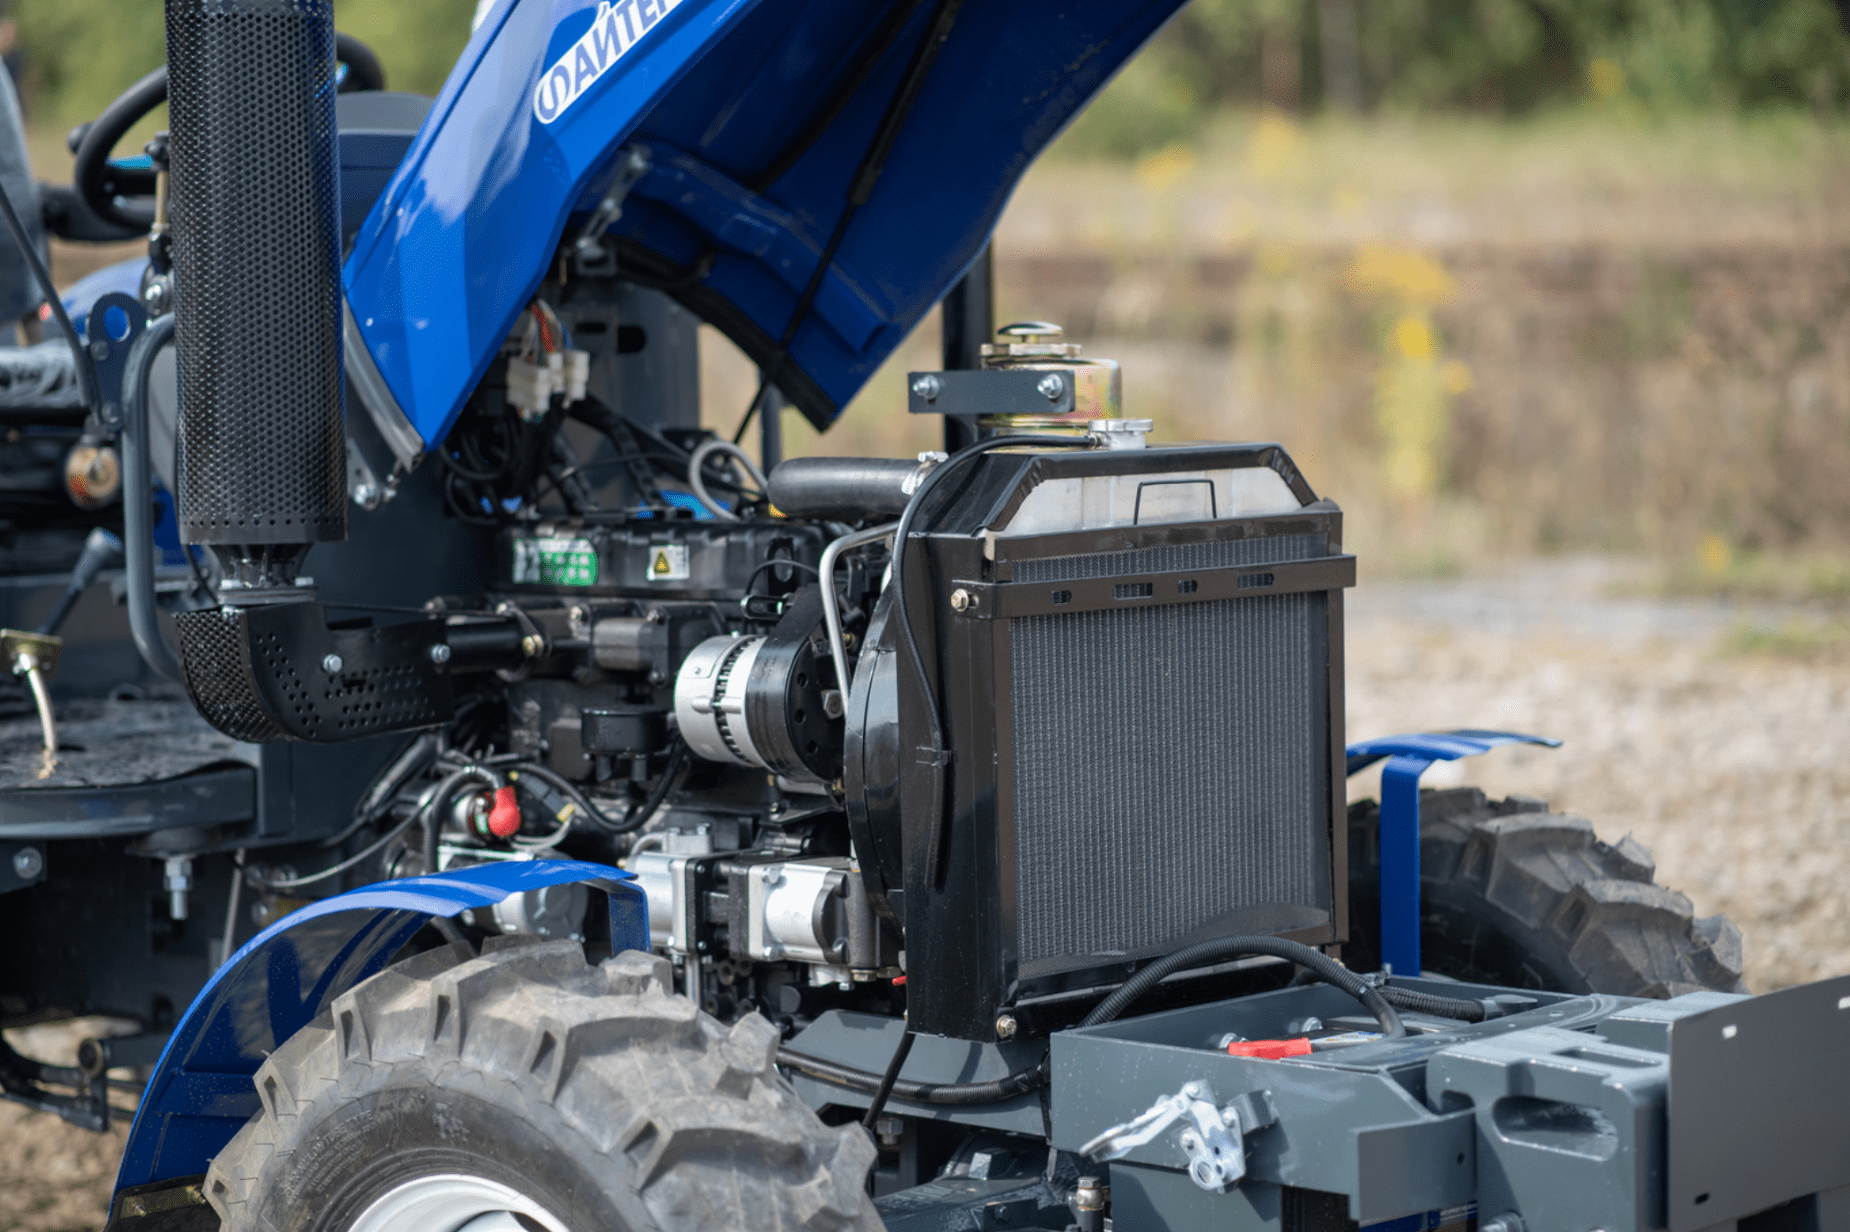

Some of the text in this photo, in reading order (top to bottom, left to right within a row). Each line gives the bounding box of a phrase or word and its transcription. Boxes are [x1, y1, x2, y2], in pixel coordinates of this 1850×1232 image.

[297, 1141, 325, 1174] NYLON
[322, 1122, 347, 1146] TUBE
[345, 1109, 374, 1132] TYPE
